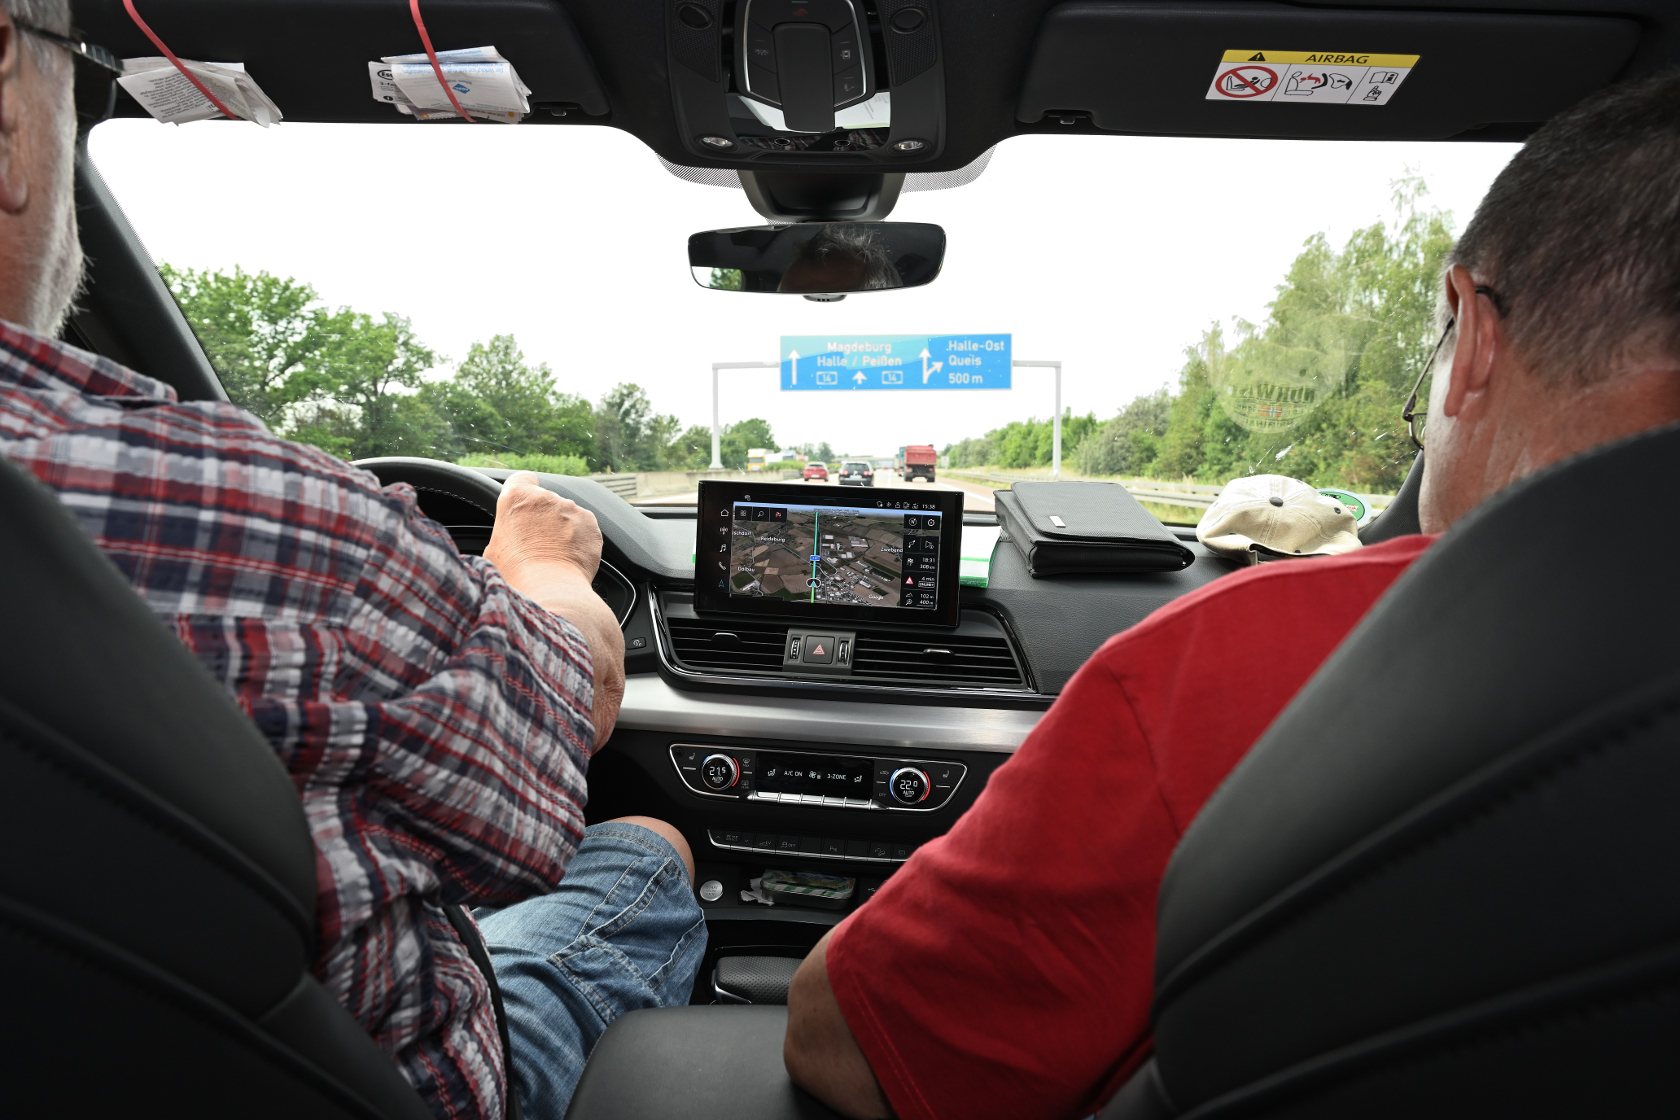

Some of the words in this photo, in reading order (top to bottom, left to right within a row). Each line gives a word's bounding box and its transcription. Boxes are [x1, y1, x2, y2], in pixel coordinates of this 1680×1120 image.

[1305, 54, 1370, 64] AIRBAG
[827, 342, 892, 354] Magdeburg
[949, 340, 1005, 352] Halle-Ost
[817, 355, 847, 367] Halle
[862, 355, 902, 367] Peißen
[949, 355, 982, 367] Queis
[822, 373, 832, 382] 14
[888, 373, 897, 382] 14
[948, 373, 971, 384] 500
[972, 375, 983, 384] m
